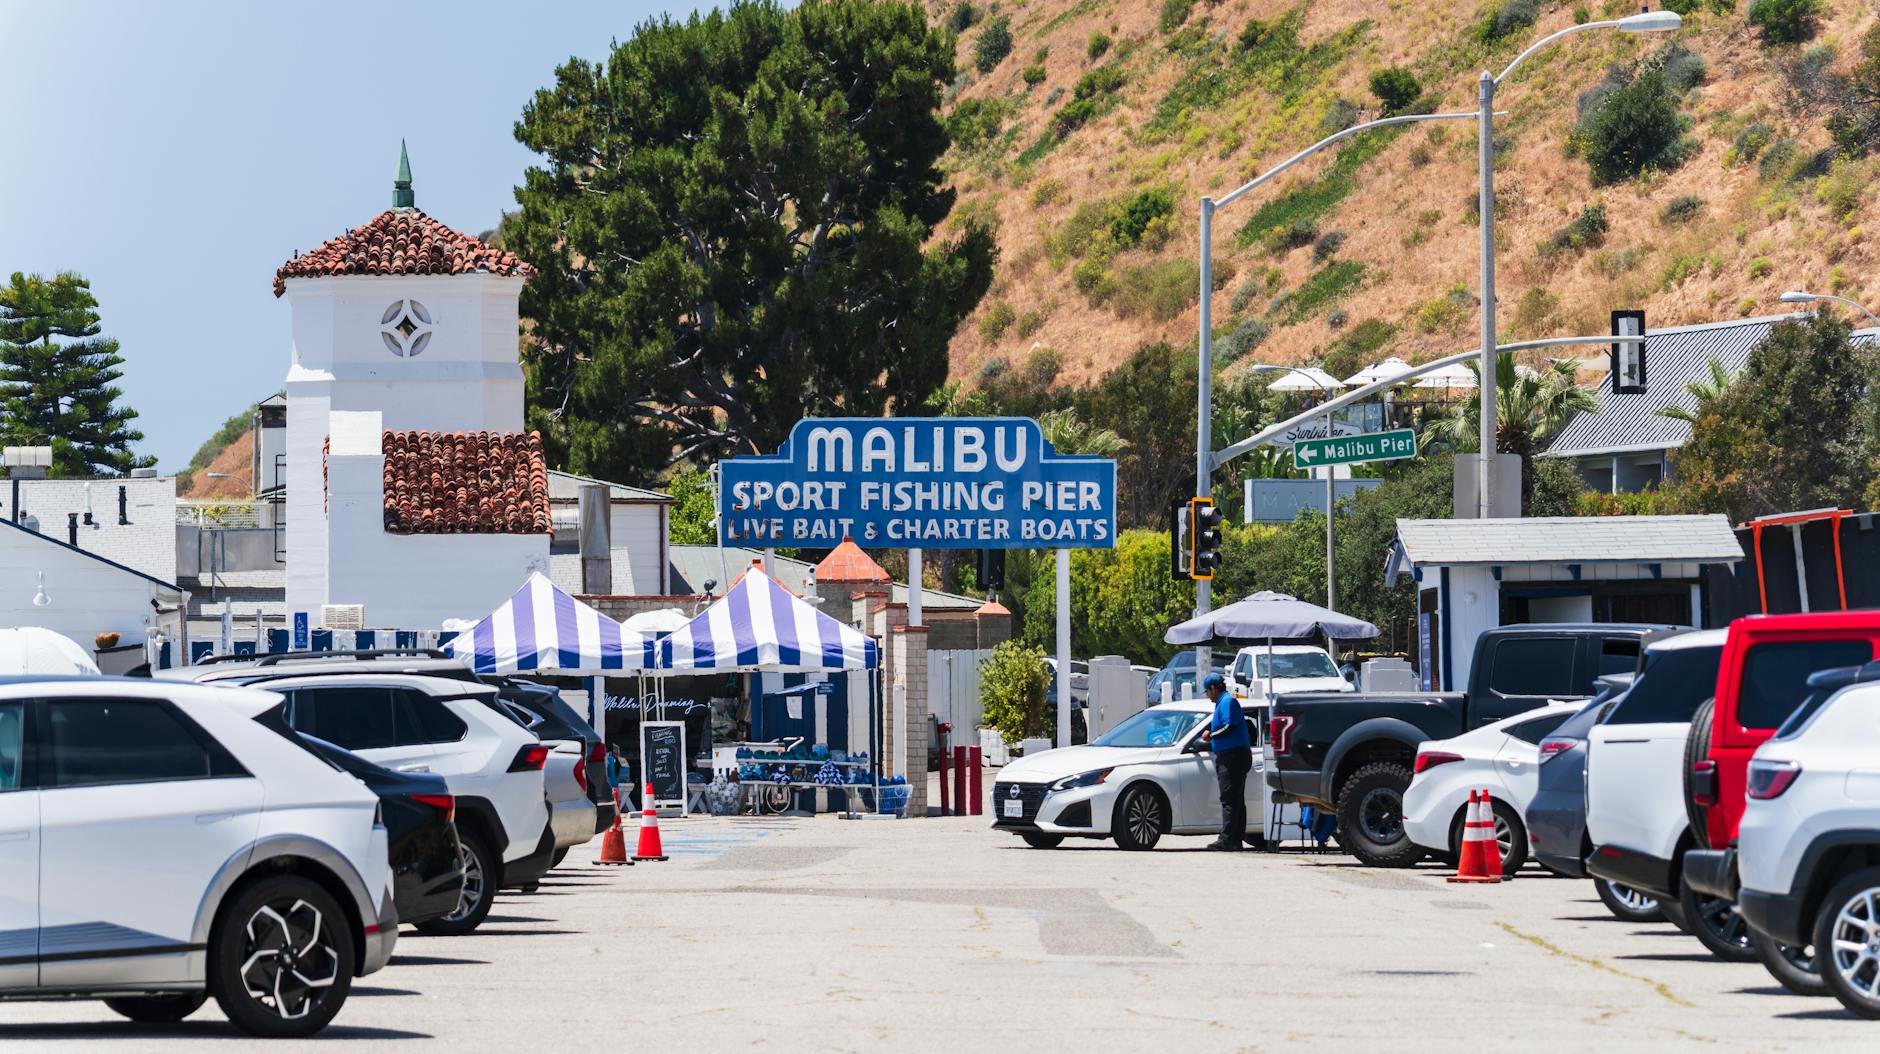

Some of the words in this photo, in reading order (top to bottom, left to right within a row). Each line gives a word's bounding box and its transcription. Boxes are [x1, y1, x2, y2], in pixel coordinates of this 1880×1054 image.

[807, 426, 1027, 473] MALIBU
[1324, 442, 1375, 459] Malibu
[1381, 438, 1412, 453] Pier
[732, 481, 847, 512] SPORT
[861, 481, 1004, 512] FISHING
[1022, 481, 1103, 512] PIER
[727, 519, 784, 541] LIVE
[793, 518, 854, 541] BAIT
[864, 521, 879, 541] &
[886, 518, 1010, 541] CHARTER
[1020, 518, 1108, 541] BOATS
